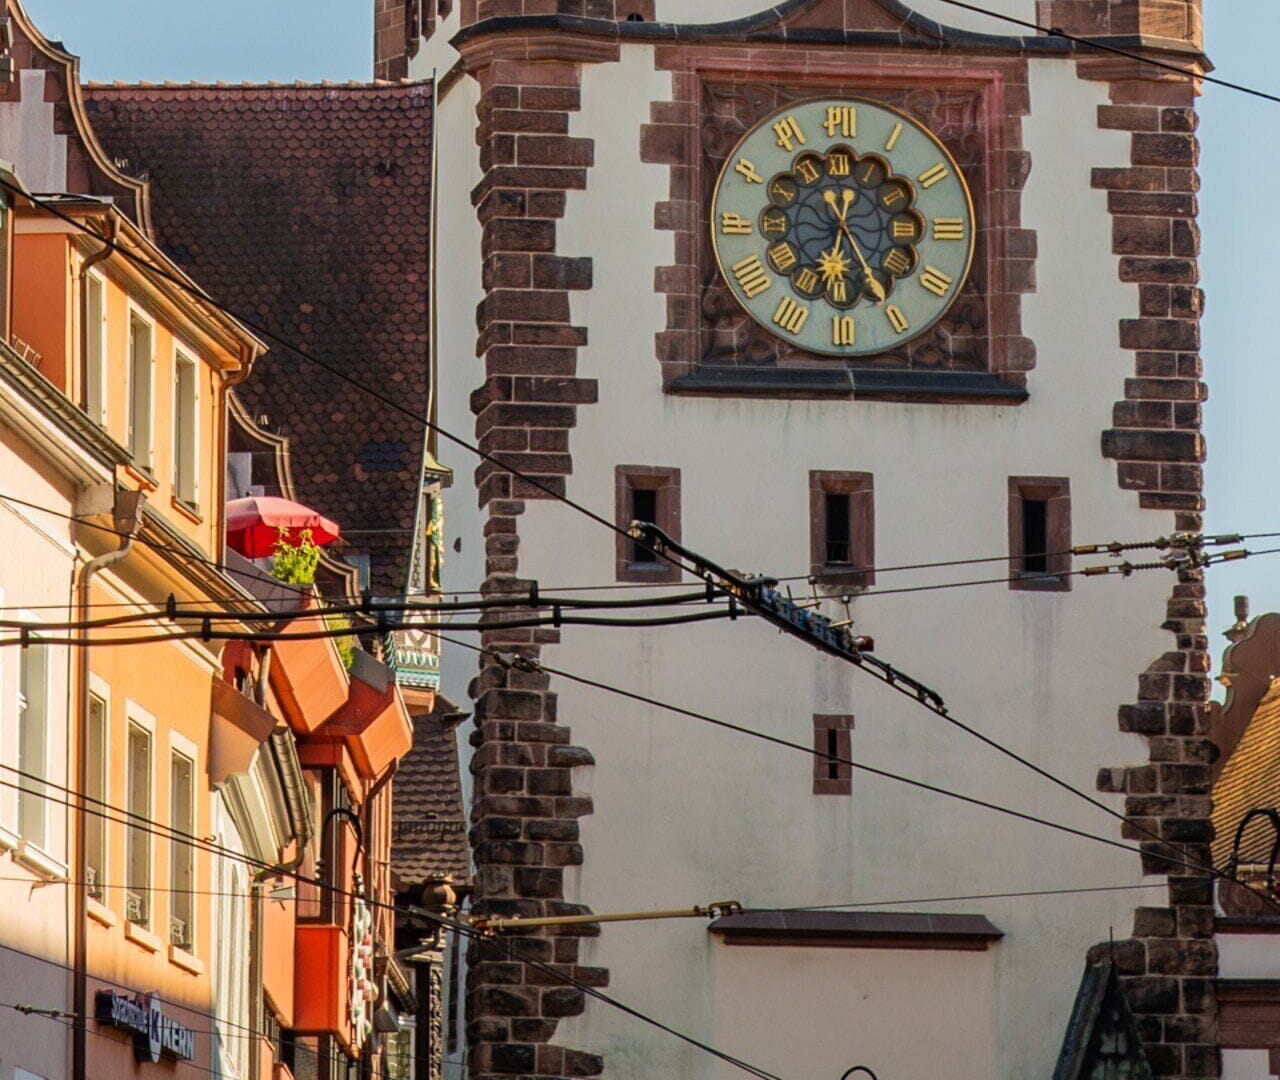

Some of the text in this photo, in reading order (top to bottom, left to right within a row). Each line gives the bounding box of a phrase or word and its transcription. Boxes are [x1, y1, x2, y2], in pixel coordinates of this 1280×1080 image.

[829, 154, 850, 176] XII
[893, 221, 914, 238] III
[933, 217, 965, 240] III
[161, 1014, 194, 1061] KERN
